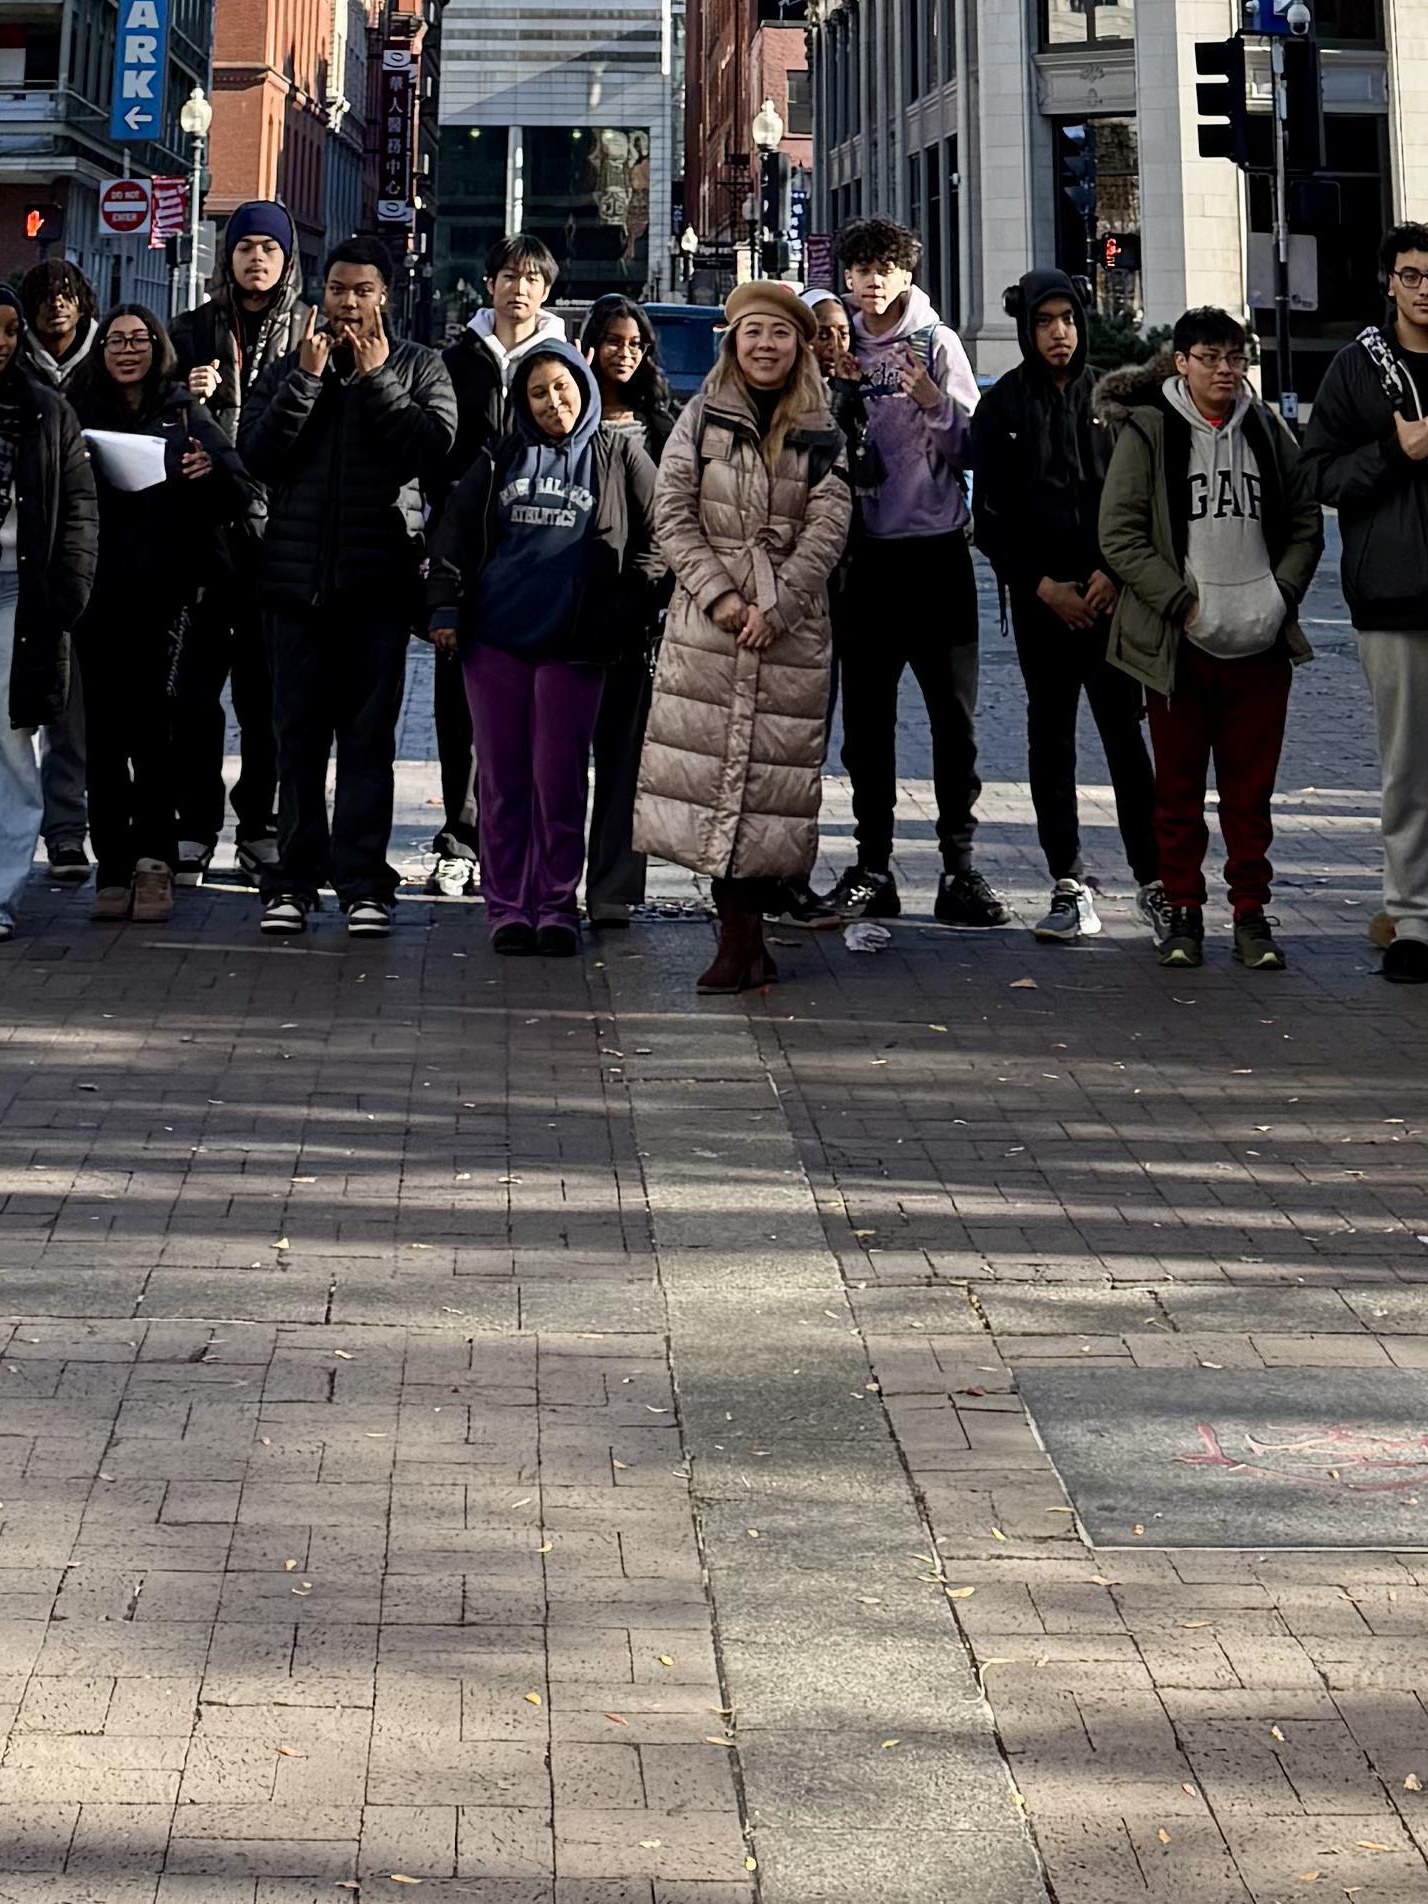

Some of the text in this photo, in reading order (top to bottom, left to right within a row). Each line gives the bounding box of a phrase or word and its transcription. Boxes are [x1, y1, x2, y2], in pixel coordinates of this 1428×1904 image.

[111, 190, 140, 200] DO NOT
[510, 504, 577, 528] ATHLETICS
